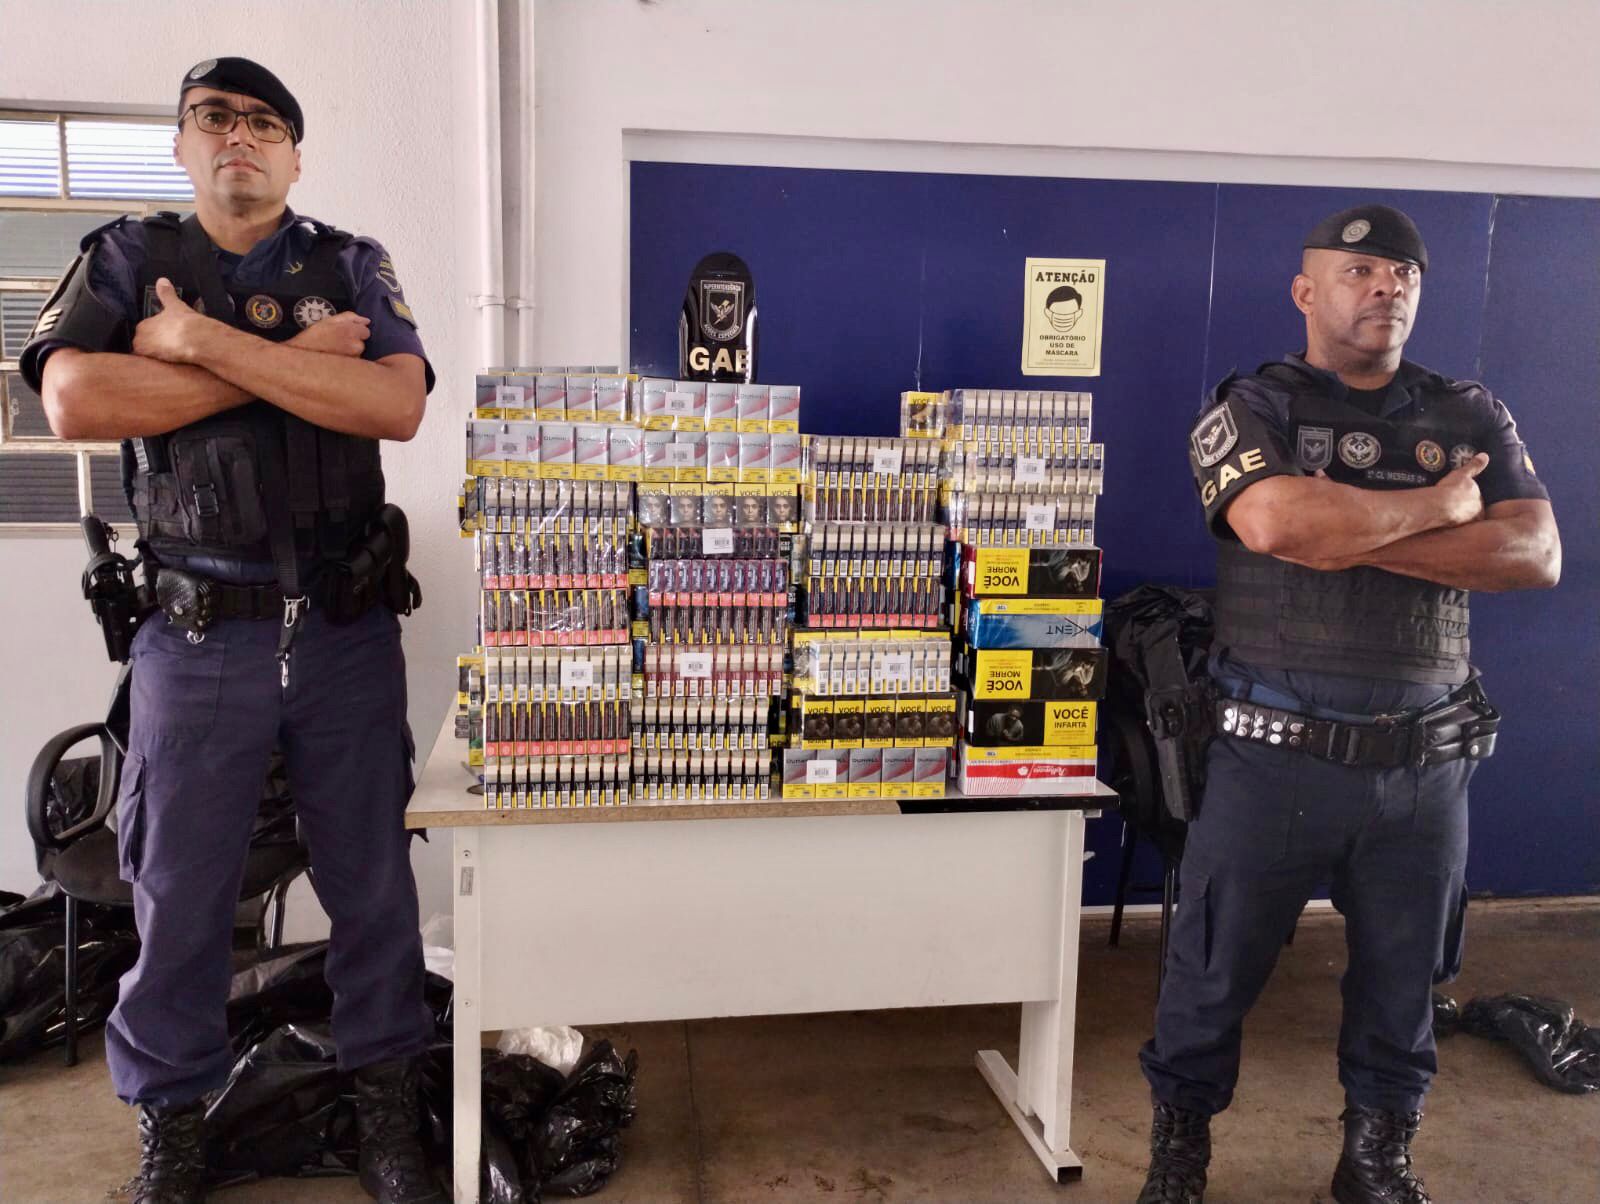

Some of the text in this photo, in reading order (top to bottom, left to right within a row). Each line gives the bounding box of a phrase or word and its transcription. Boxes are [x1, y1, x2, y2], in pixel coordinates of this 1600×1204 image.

[1035, 270, 1095, 285] ATENÇÃO
[689, 346, 748, 374] GAE
[1201, 448, 1267, 507] GAE
[984, 575, 1020, 589] VOCÊ
[1047, 617, 1088, 637] KENT
[990, 670, 1021, 678] MORRE
[986, 680, 1023, 693] VOCÊ
[1053, 706, 1089, 719] VOCÊ
[1054, 721, 1087, 729] INFARTA
